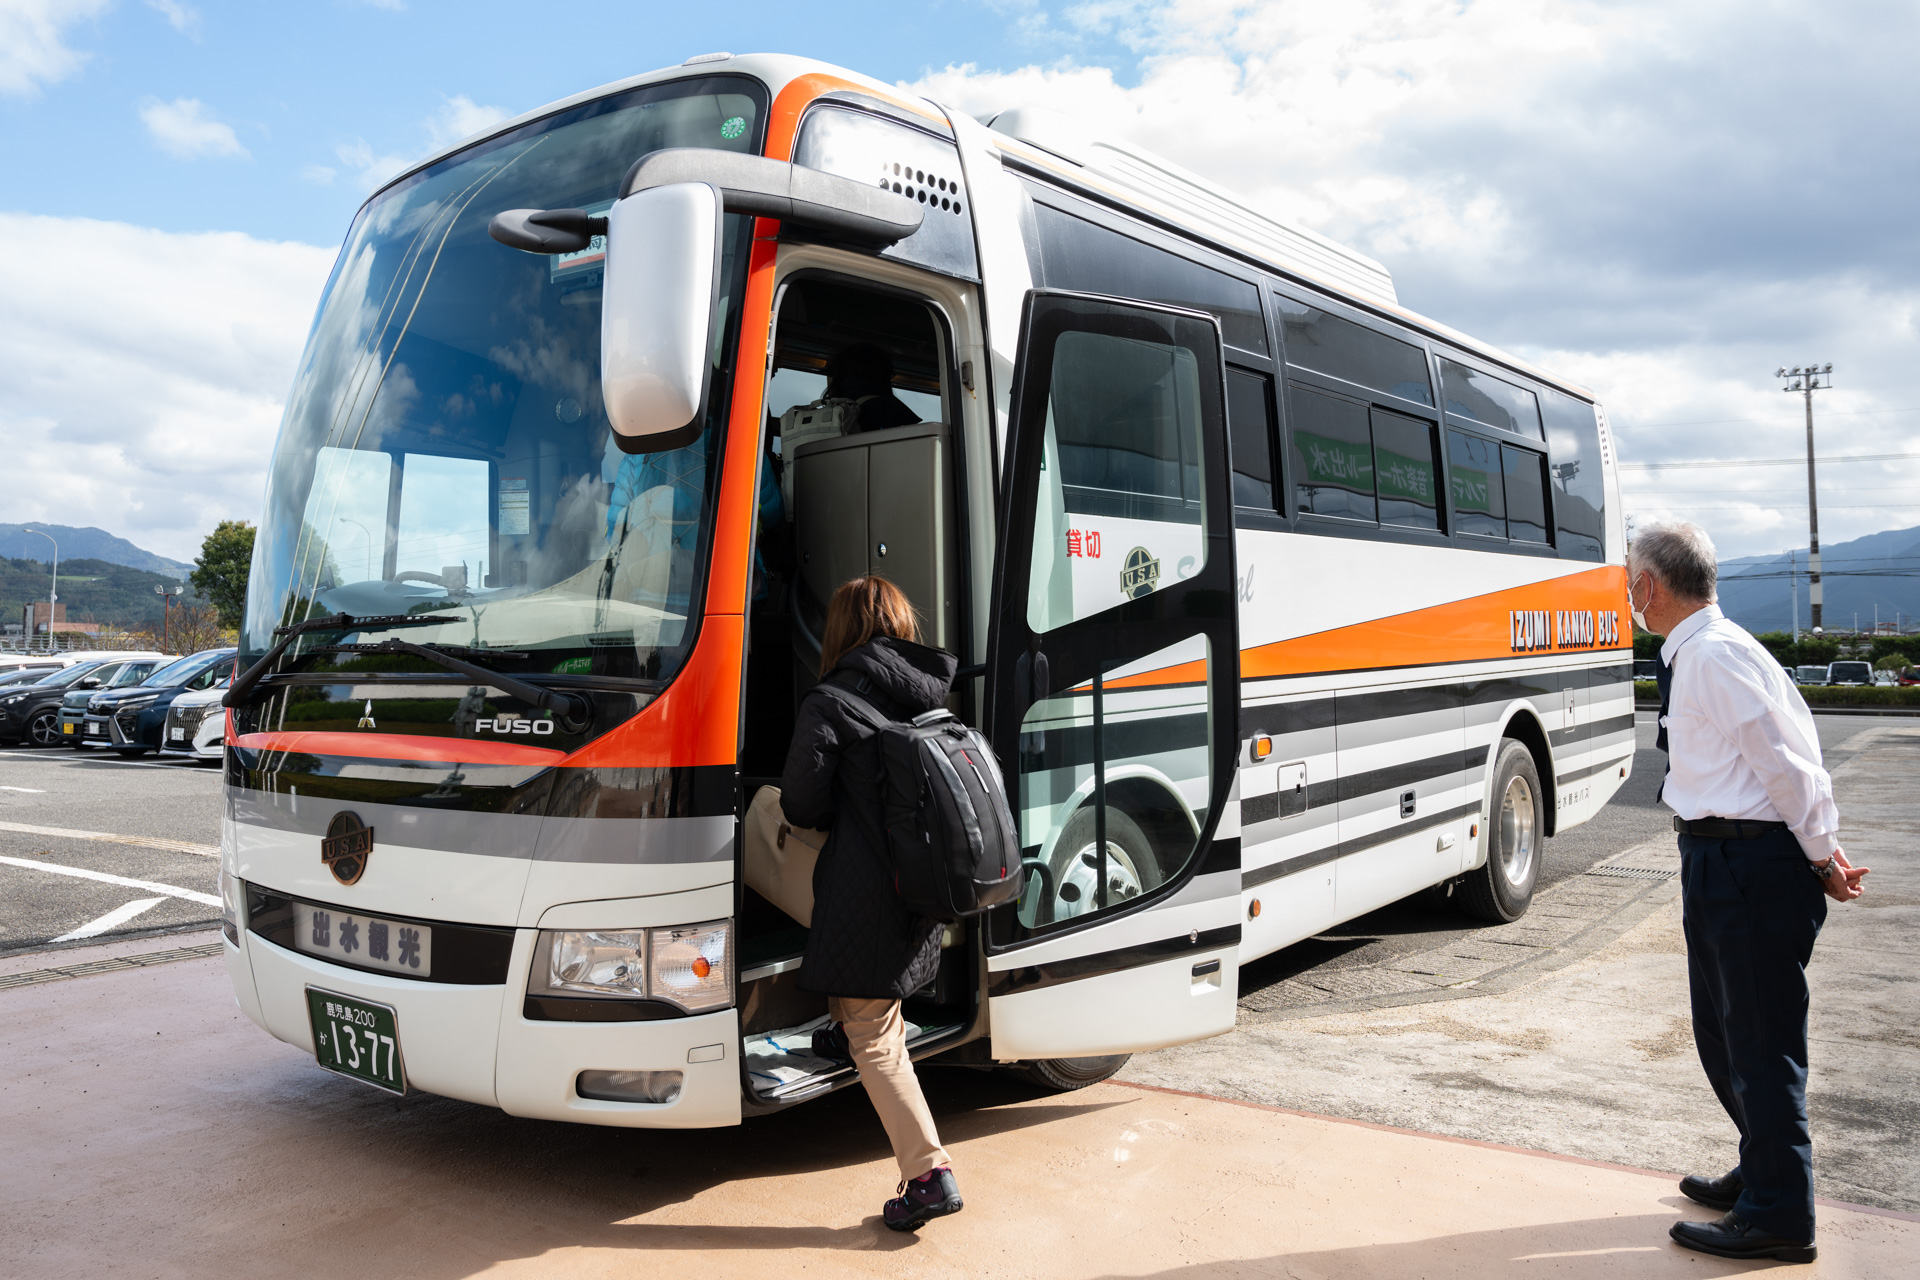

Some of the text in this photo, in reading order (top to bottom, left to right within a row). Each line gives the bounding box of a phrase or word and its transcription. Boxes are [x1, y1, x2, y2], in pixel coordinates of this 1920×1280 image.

[1065, 529, 1101, 558] 貸切
[1125, 563, 1159, 587] USA
[1509, 610, 1619, 652] IZUMI KANKO BUS
[475, 719, 554, 735] FUSO
[326, 833, 366, 858] USA
[312, 911, 421, 969] 出水観光
[326, 1001, 375, 1028] 鹿児島200
[320, 1020, 394, 1081] か 13-77
